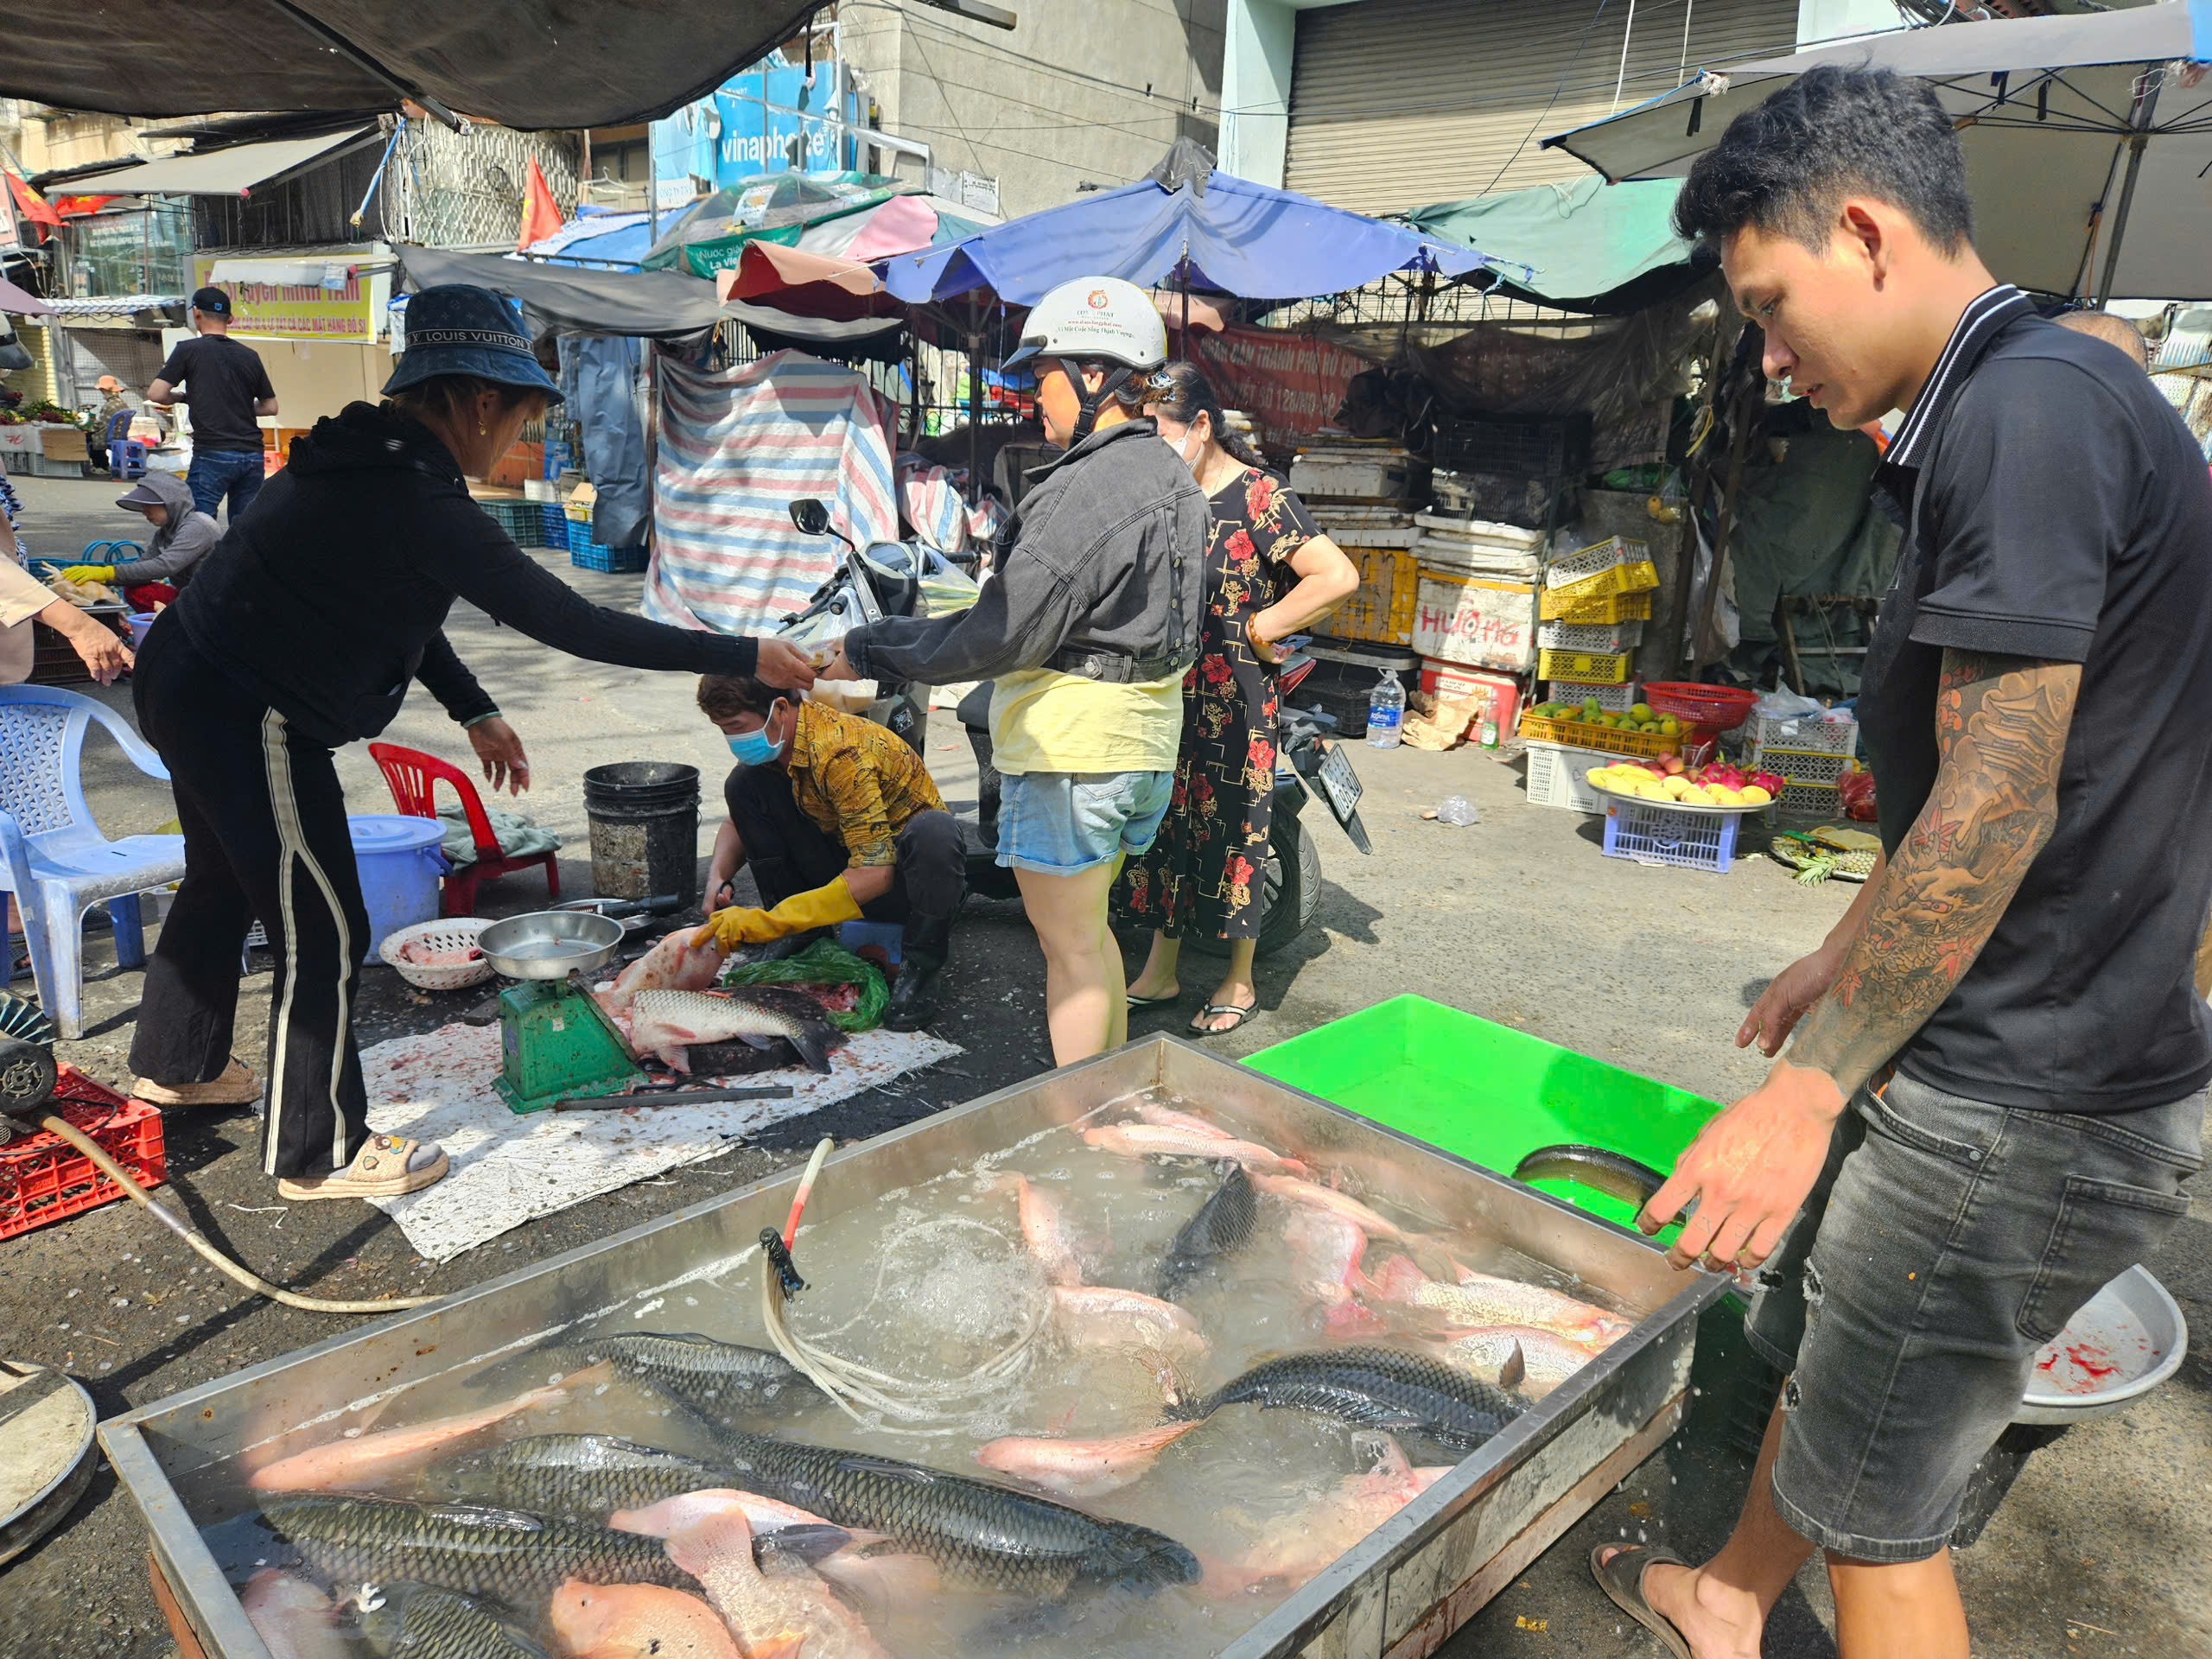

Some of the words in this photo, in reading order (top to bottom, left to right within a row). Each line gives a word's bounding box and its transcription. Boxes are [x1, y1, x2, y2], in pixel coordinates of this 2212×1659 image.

[426, 331, 467, 341] LOUIS
[471, 332, 524, 346] VUITTON
[1336, 772, 1360, 815] 096.90
